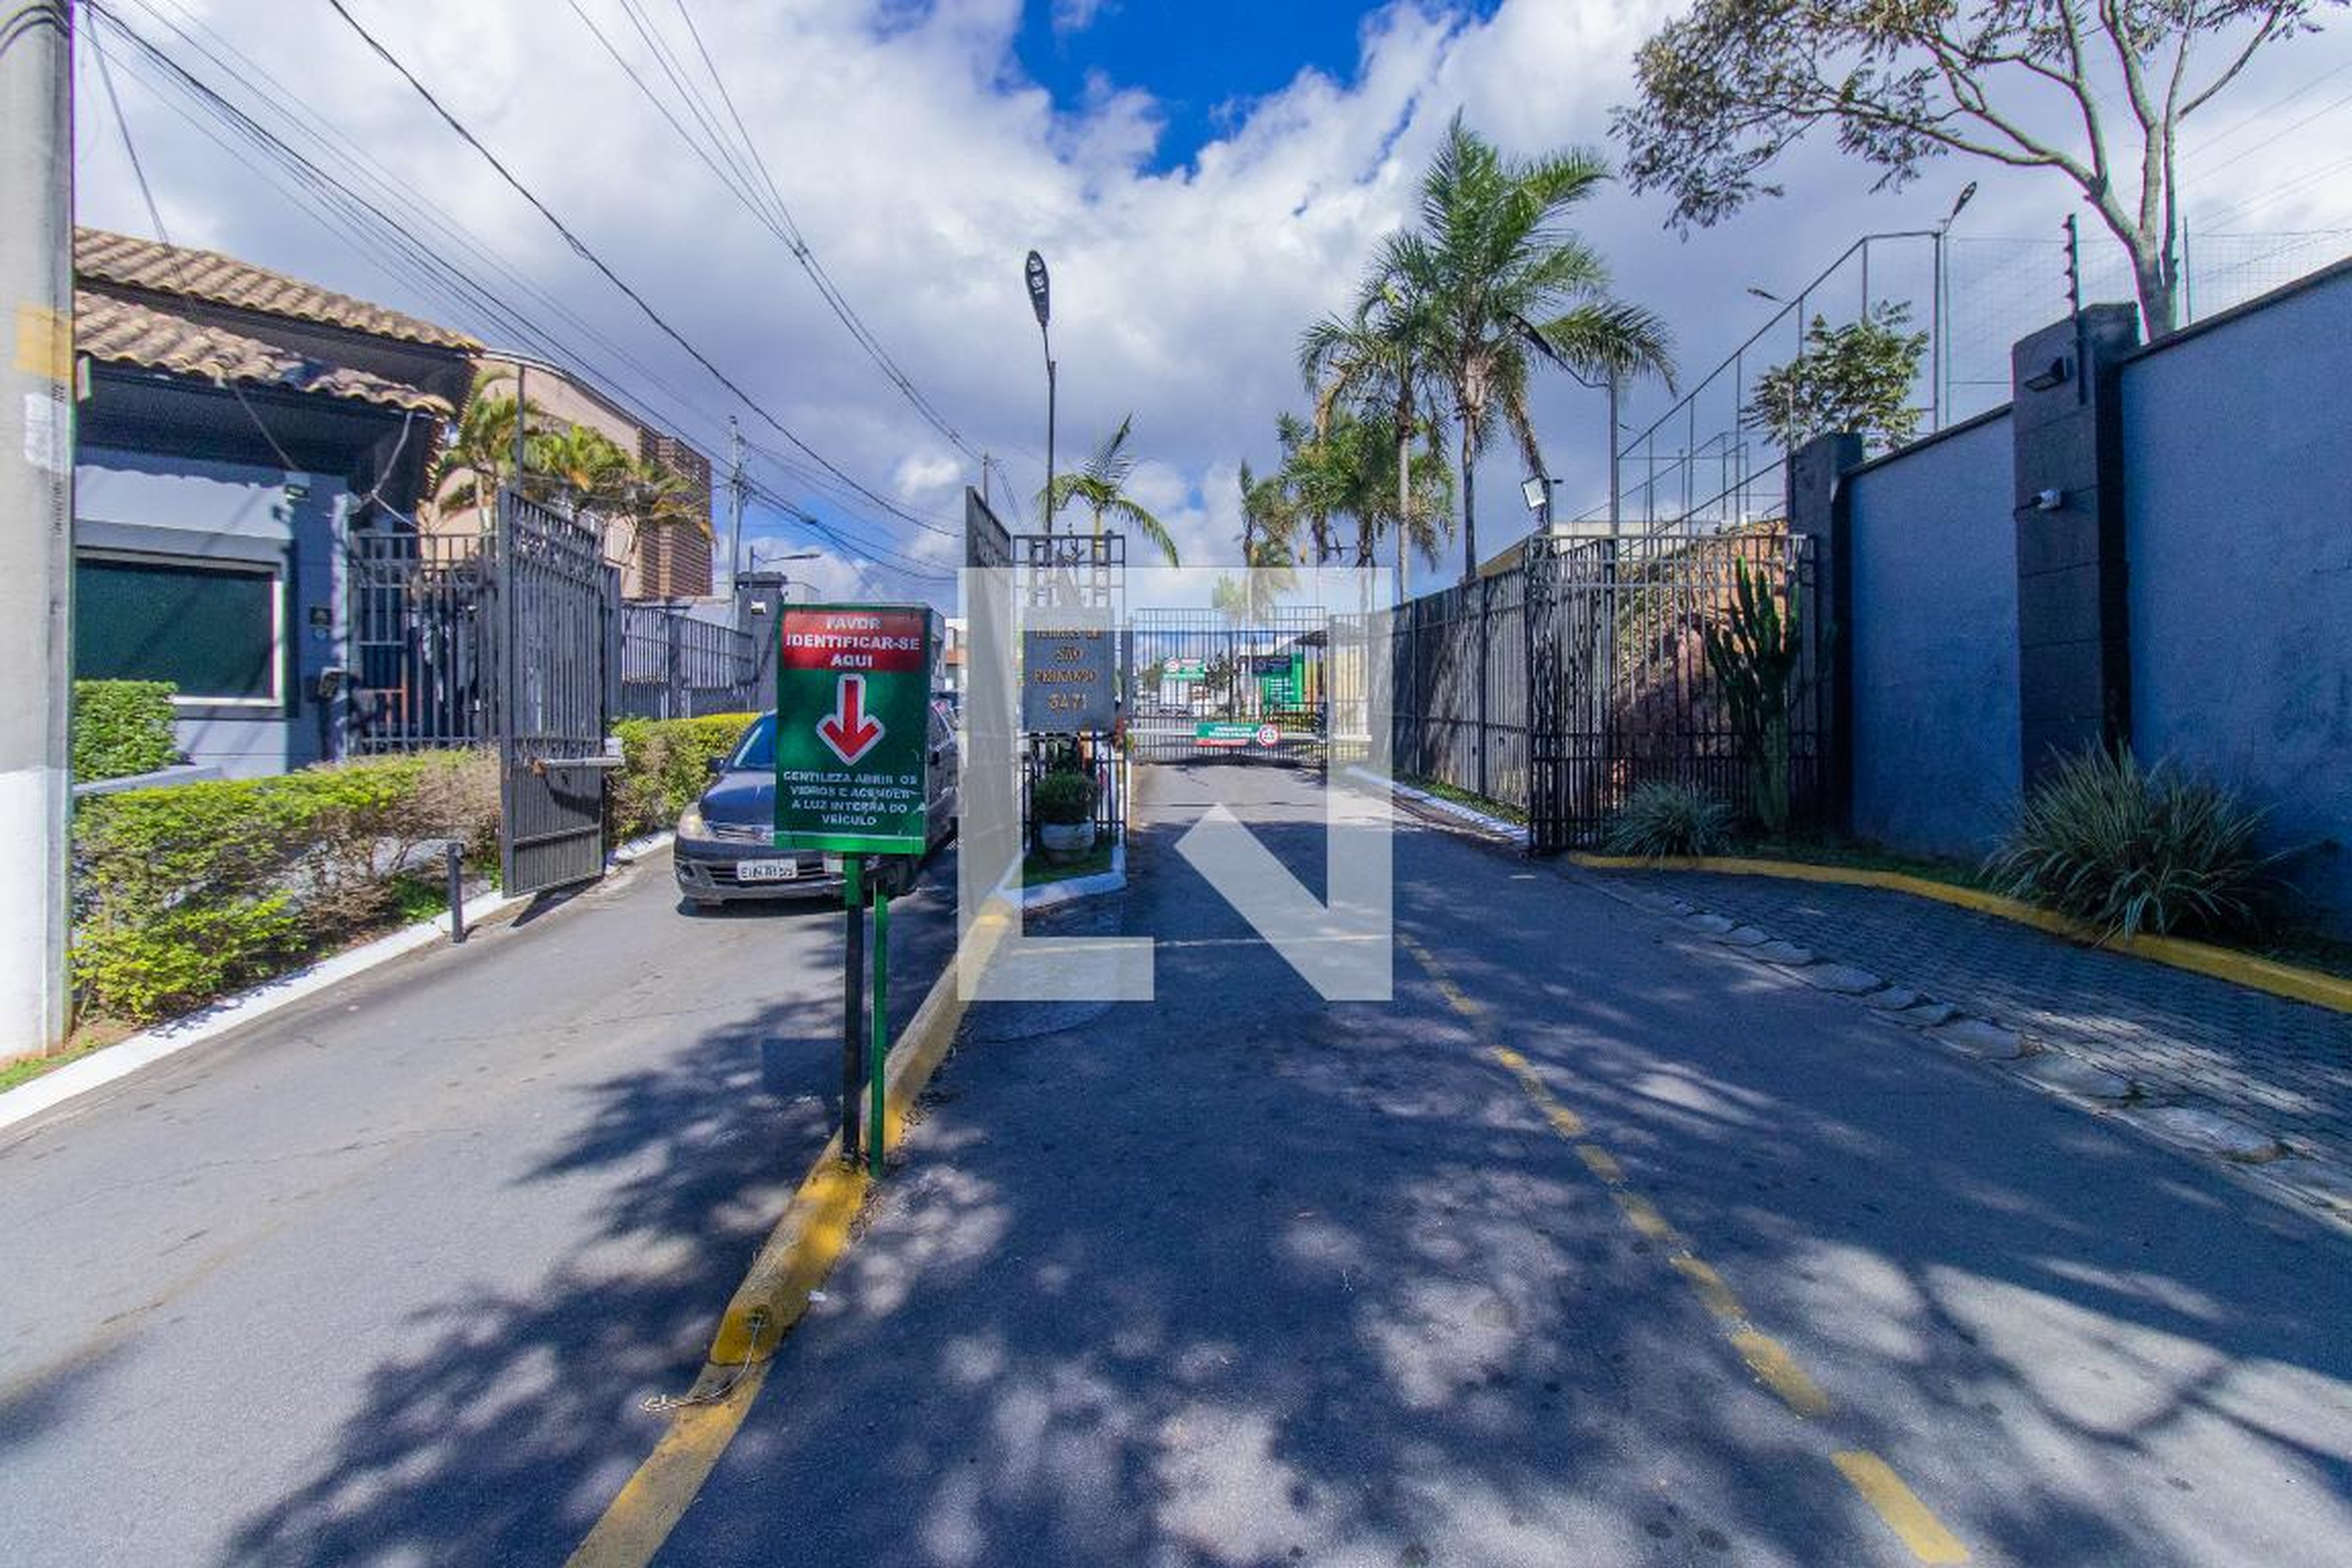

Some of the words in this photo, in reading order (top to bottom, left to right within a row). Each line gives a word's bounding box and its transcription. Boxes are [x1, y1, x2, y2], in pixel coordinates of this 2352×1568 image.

[826, 617, 882, 630] FAVOR
[786, 634, 920, 650] IDENTIFICAR-SE
[831, 654, 872, 667] AQUI
[783, 771, 851, 783] GENTILEZA
[791, 799, 801, 810] A
[803, 799, 827, 810] LUZ
